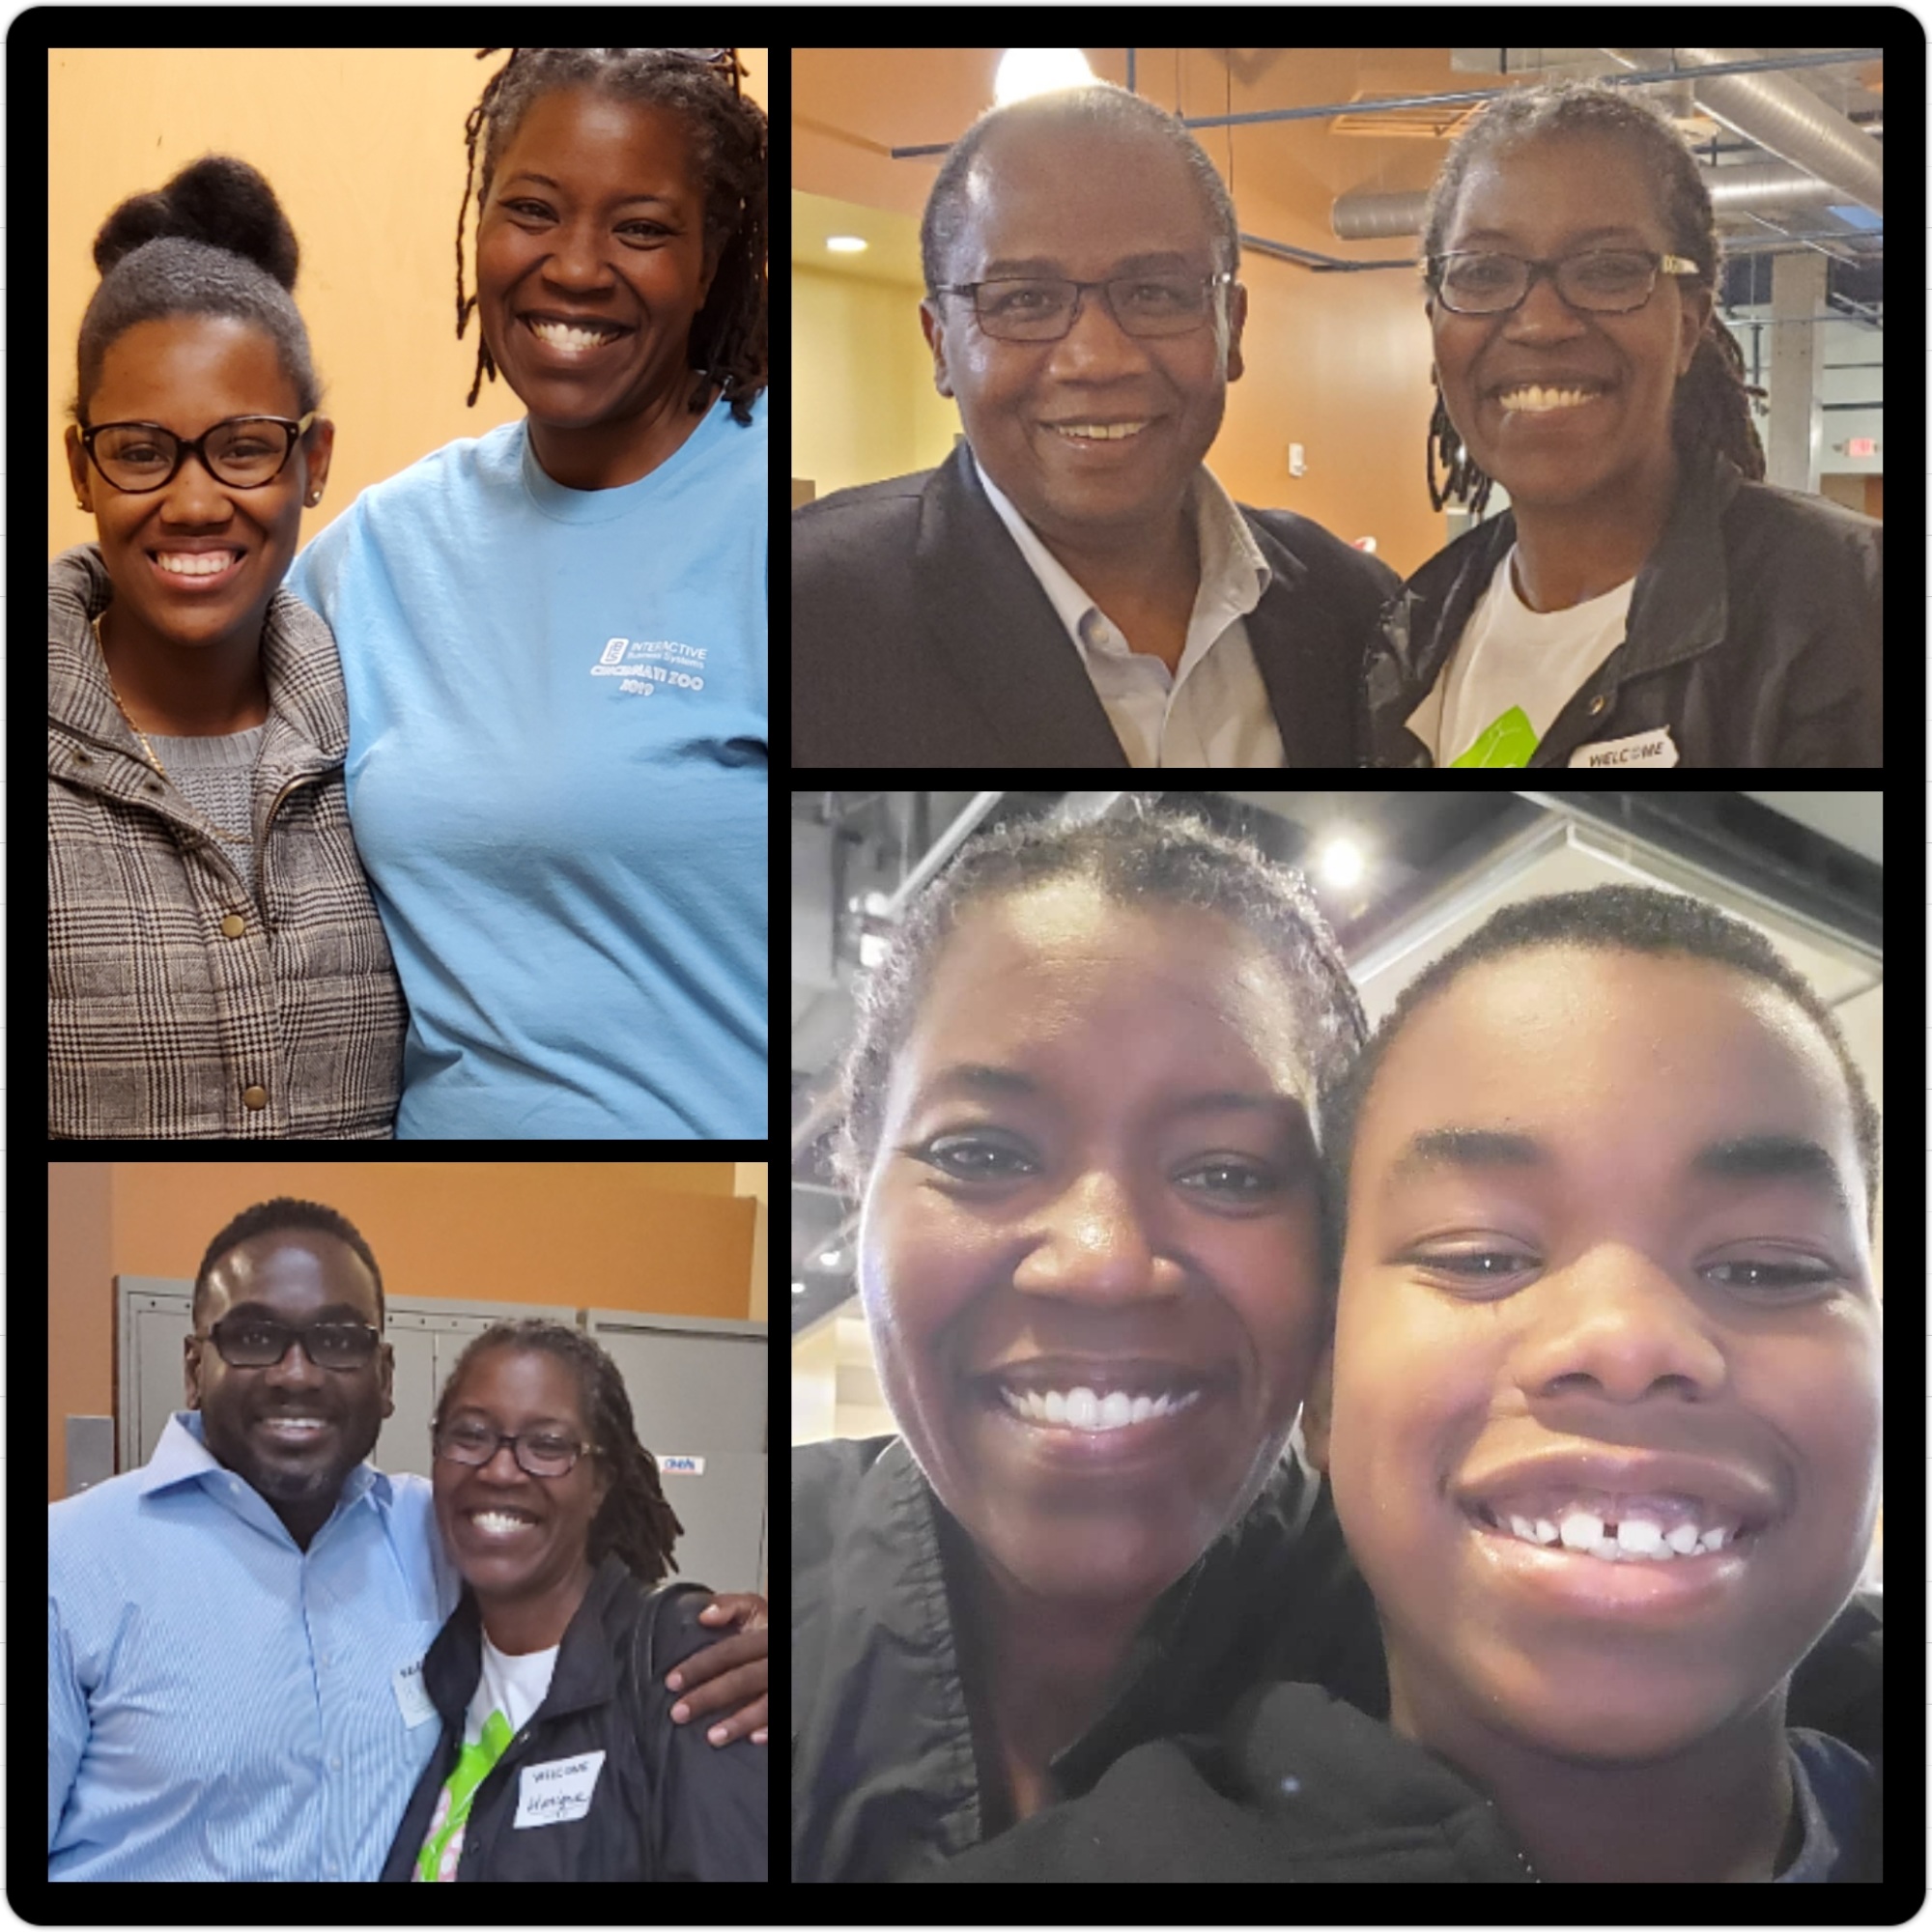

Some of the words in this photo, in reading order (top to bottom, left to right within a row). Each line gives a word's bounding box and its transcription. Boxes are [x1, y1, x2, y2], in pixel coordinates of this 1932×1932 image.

[631, 641, 708, 660] INTERACTIVE
[668, 670, 704, 691] ZOO
[1589, 741, 1663, 767] WELCOME
